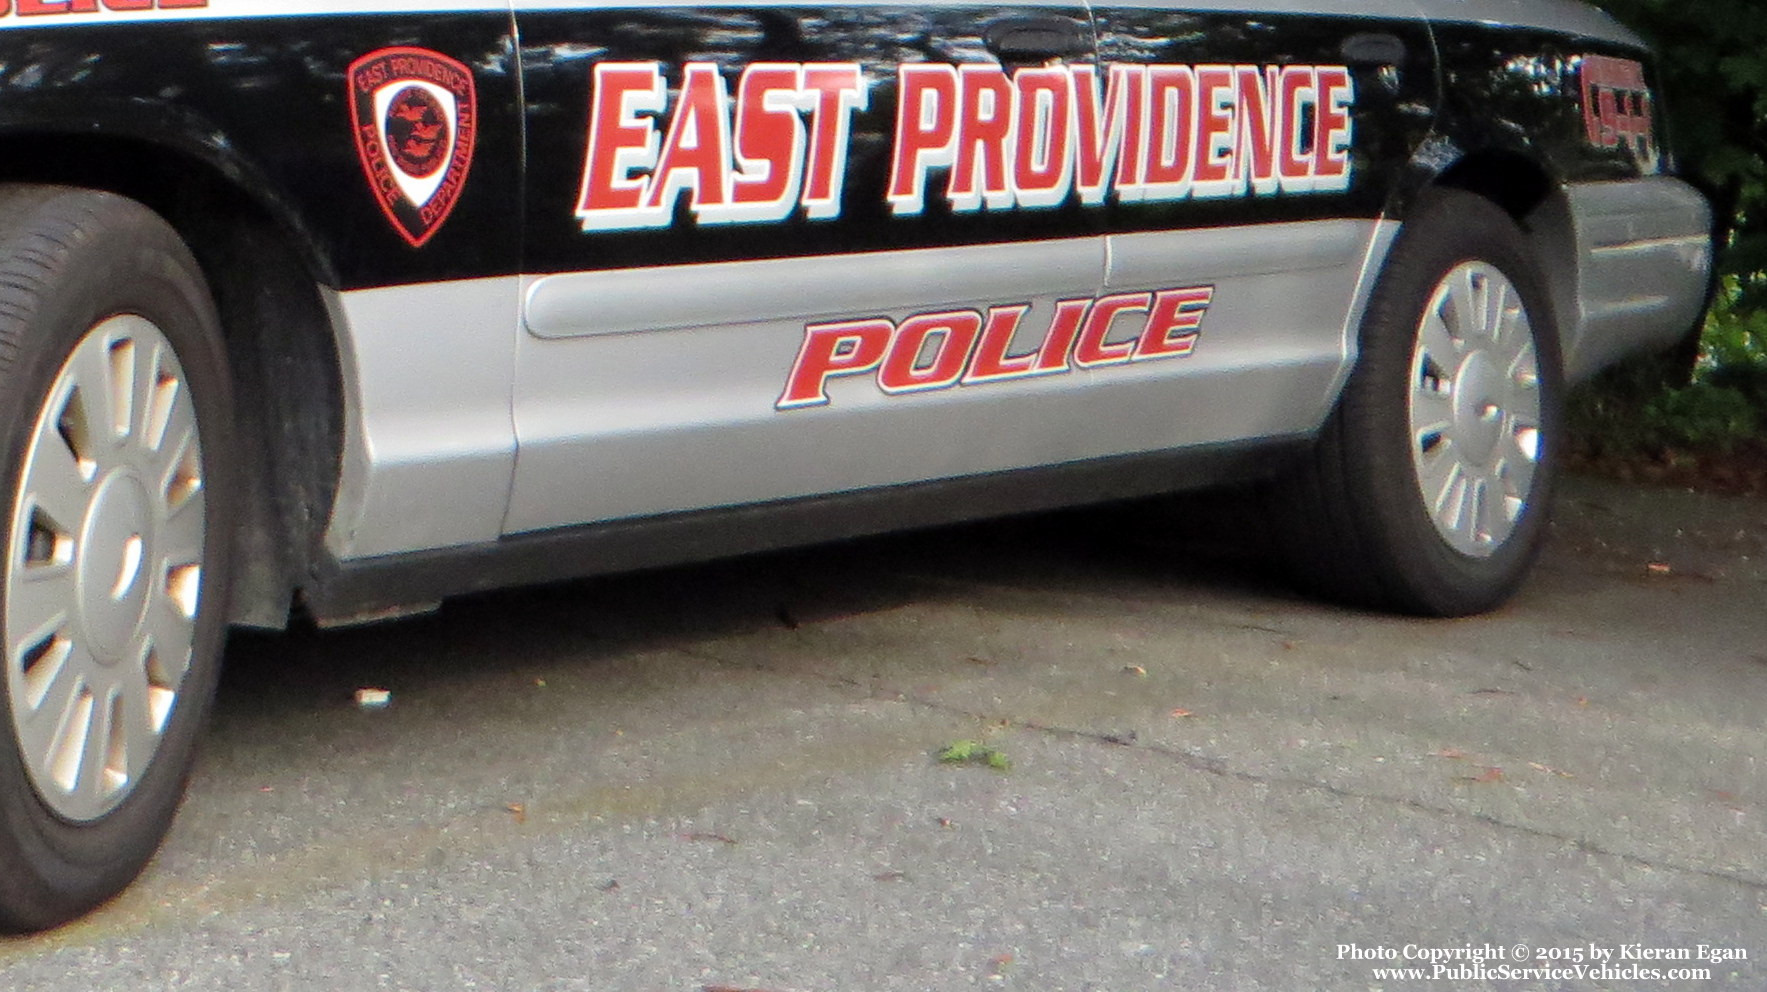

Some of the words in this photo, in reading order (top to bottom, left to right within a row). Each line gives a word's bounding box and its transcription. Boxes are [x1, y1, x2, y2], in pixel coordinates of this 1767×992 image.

[355, 60, 389, 92] EAST
[390, 57, 470, 97] PROVIDENCE
[360, 123, 401, 205] POLICE
[575, 62, 869, 232] EAST
[887, 62, 1354, 215] PROVIDENCE
[775, 284, 1215, 410] POLICE
